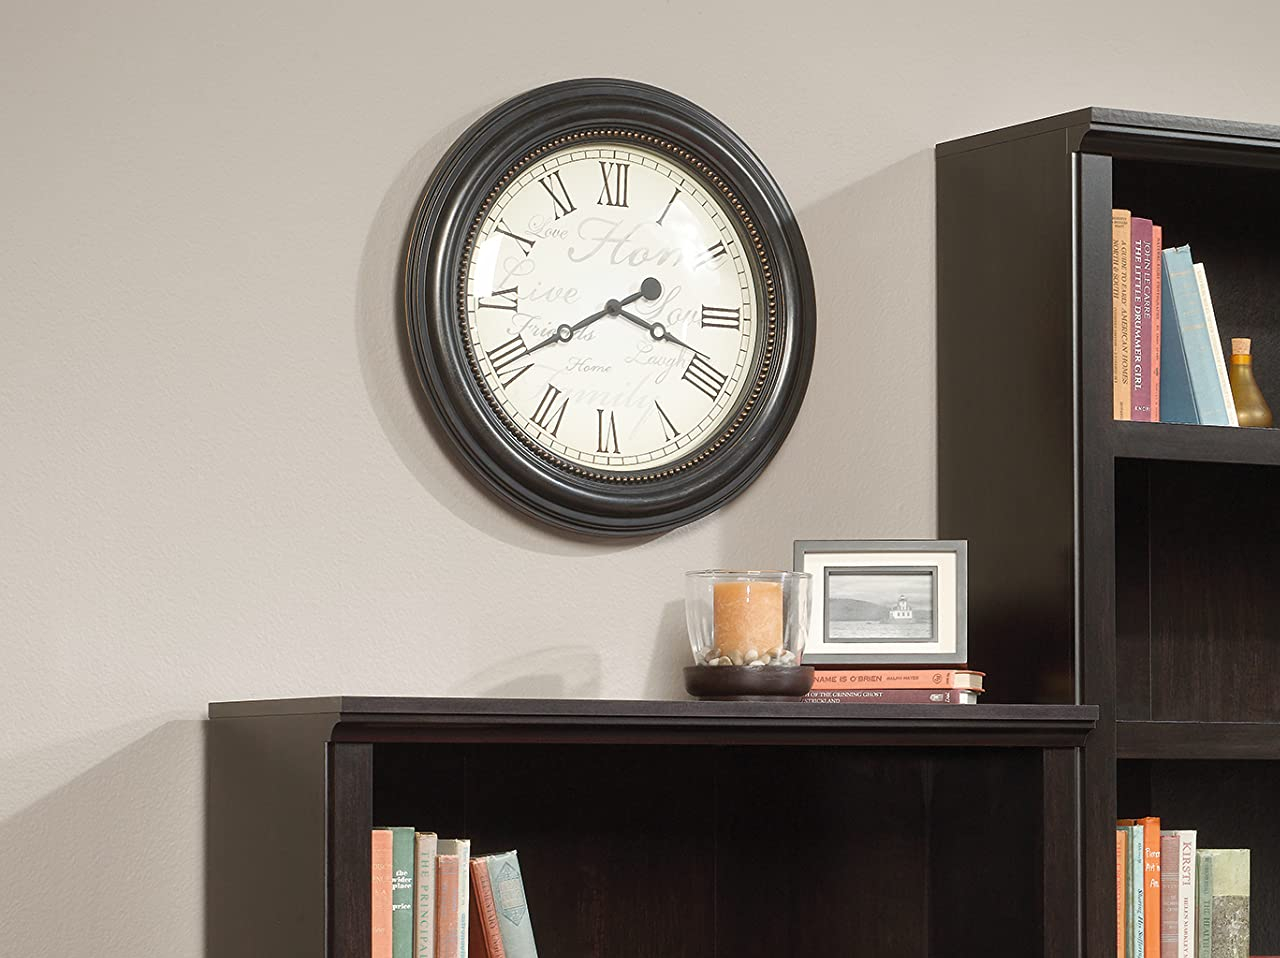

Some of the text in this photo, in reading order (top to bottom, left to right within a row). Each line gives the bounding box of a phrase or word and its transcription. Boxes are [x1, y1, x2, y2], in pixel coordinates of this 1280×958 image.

[538, 170, 577, 220] XI
[597, 161, 630, 208] XII
[494, 217, 537, 257] X
[525, 214, 569, 240] Love
[1143, 240, 1151, 270] JOHN
[1120, 271, 1127, 282] TO
[1143, 272, 1151, 284] LE
[635, 284, 704, 327] Lov
[1120, 283, 1128, 305] EARLY
[701, 304, 741, 332] III
[1134, 305, 1142, 363] DRUMMER
[566, 357, 612, 374] Home
[1134, 364, 1142, 391] GIRL
[529, 383, 571, 439] VII
[654, 400, 681, 443] V
[597, 408, 621, 455] VI
[395, 869, 408, 877] the
[420, 852, 429, 877] THE
[1182, 842, 1192, 886] KIRSTI
[392, 882, 412, 890] place
[392, 902, 411, 911] price
[1203, 917, 1211, 948] HEALTH
